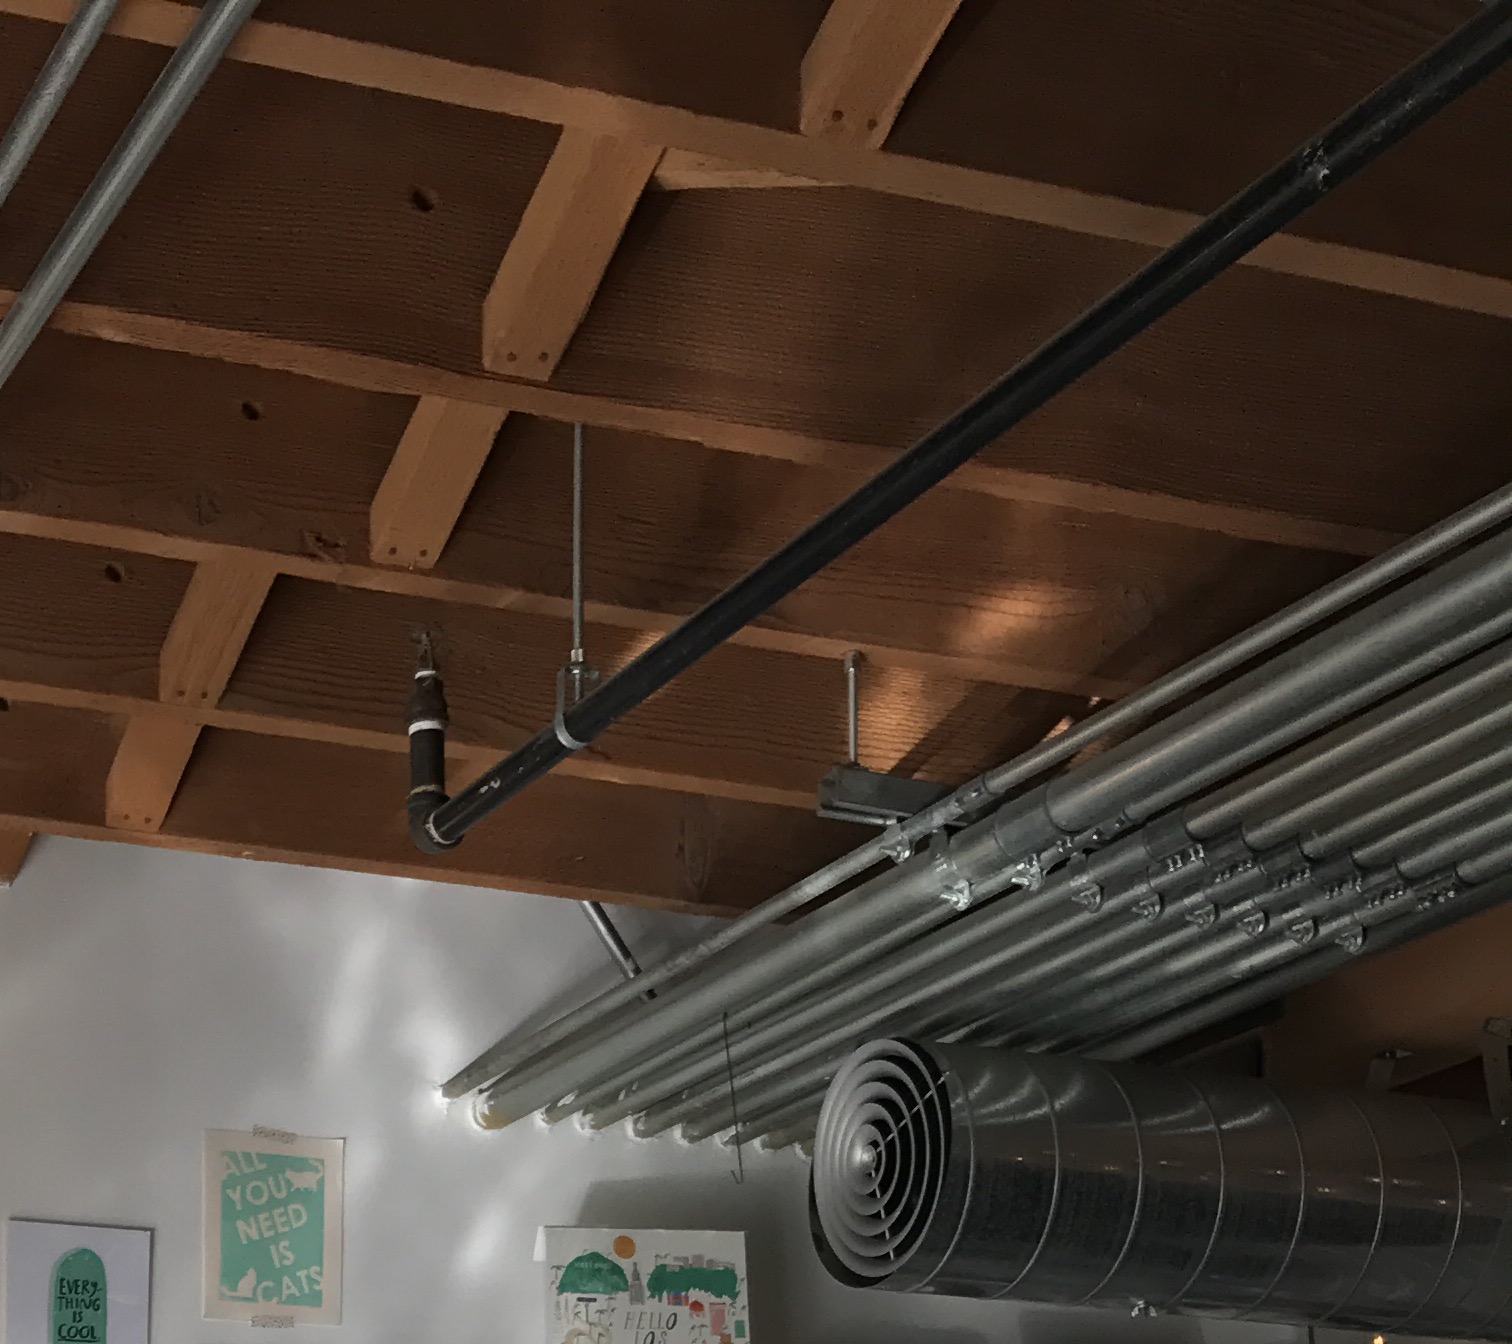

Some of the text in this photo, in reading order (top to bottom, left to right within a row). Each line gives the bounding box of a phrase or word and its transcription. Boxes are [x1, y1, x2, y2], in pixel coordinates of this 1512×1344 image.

[222, 1150, 267, 1177] ALL
[226, 1172, 287, 1211] YOU
[235, 1203, 307, 1245] NEED
[270, 1239, 295, 1269] IS
[255, 1266, 324, 1303] CATS
[56, 1295, 101, 1311] THING
[57, 1322, 98, 1339] COOL
[71, 1310, 84, 1324] IS
[623, 1310, 678, 1331] HELLO
